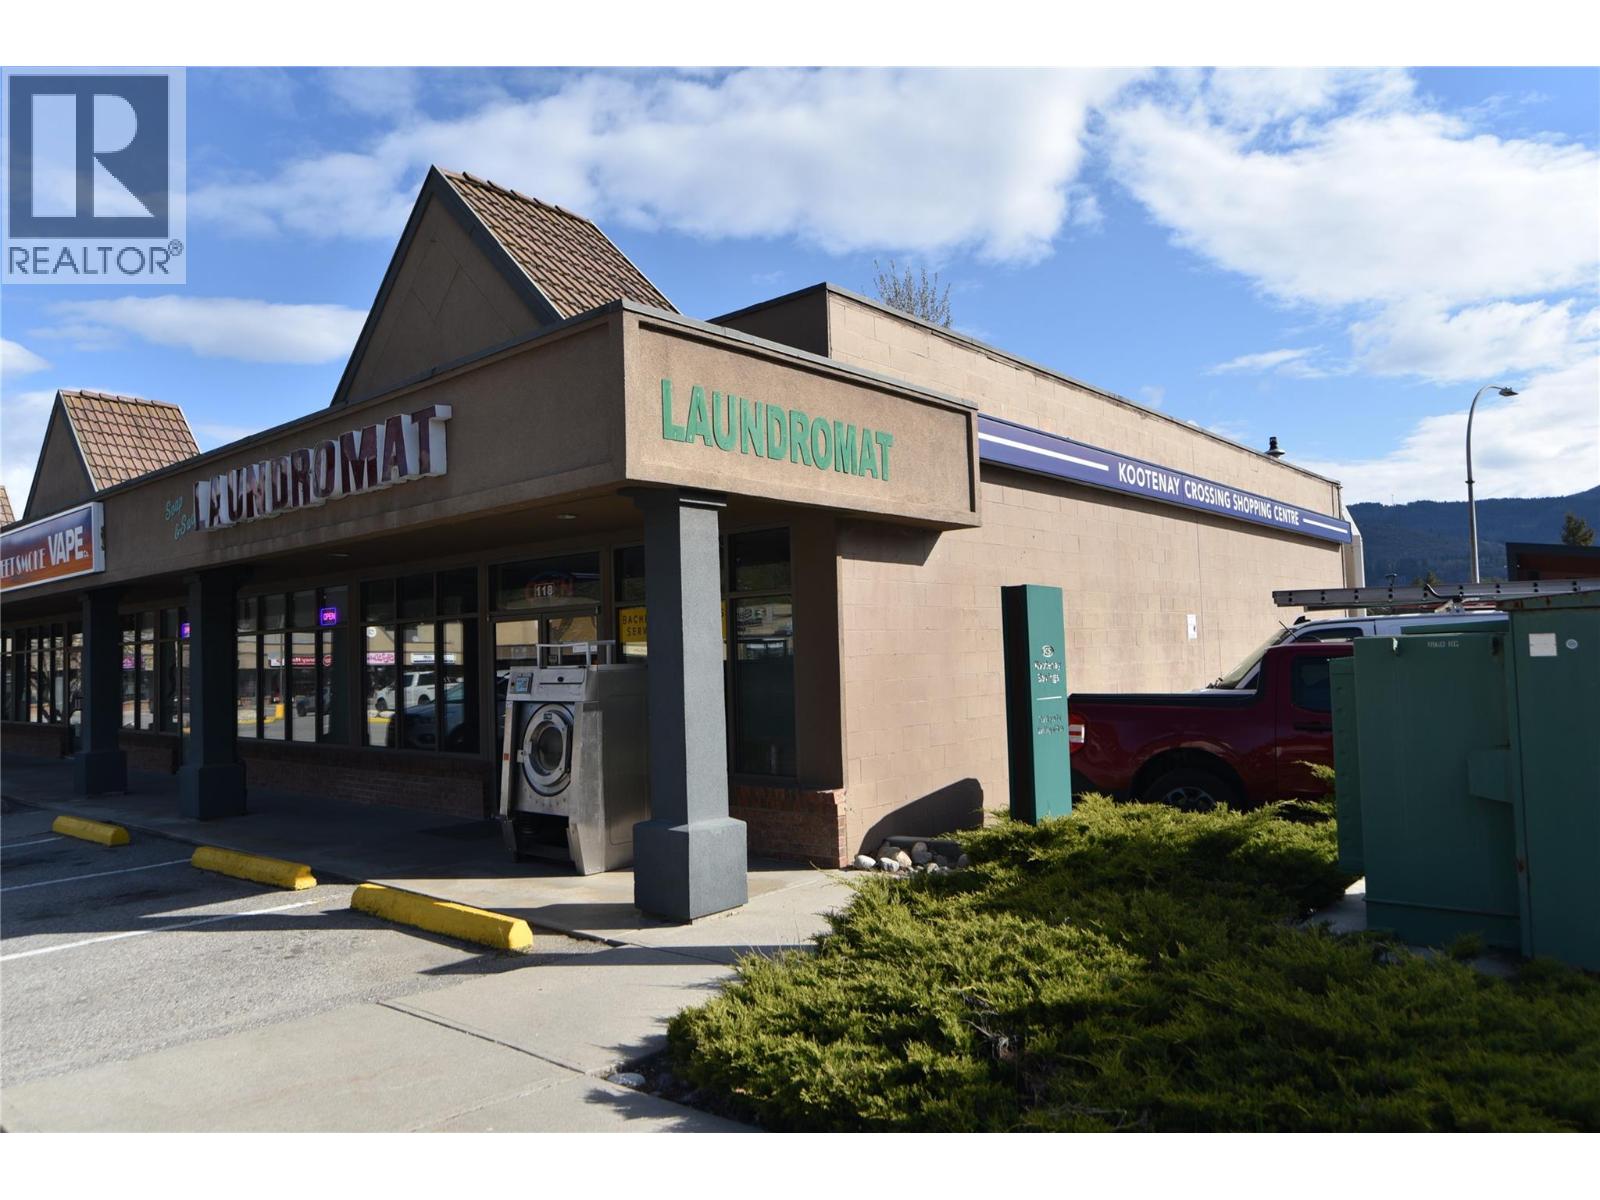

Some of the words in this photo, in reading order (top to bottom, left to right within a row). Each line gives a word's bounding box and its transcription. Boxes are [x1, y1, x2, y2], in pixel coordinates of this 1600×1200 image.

[661, 378, 895, 481] LAUNDROMAT
[193, 404, 452, 531] LAUNDROMAT
[1118, 462, 1180, 495] KOOTENAY
[1184, 480, 1231, 508] CROSSING
[1233, 493, 1272, 520] SHOPPING
[1274, 506, 1300, 526] CENTRE
[48, 526, 83, 566] VAPE
[323, 612, 336, 620] OPEN
[535, 585, 553, 597] 118
